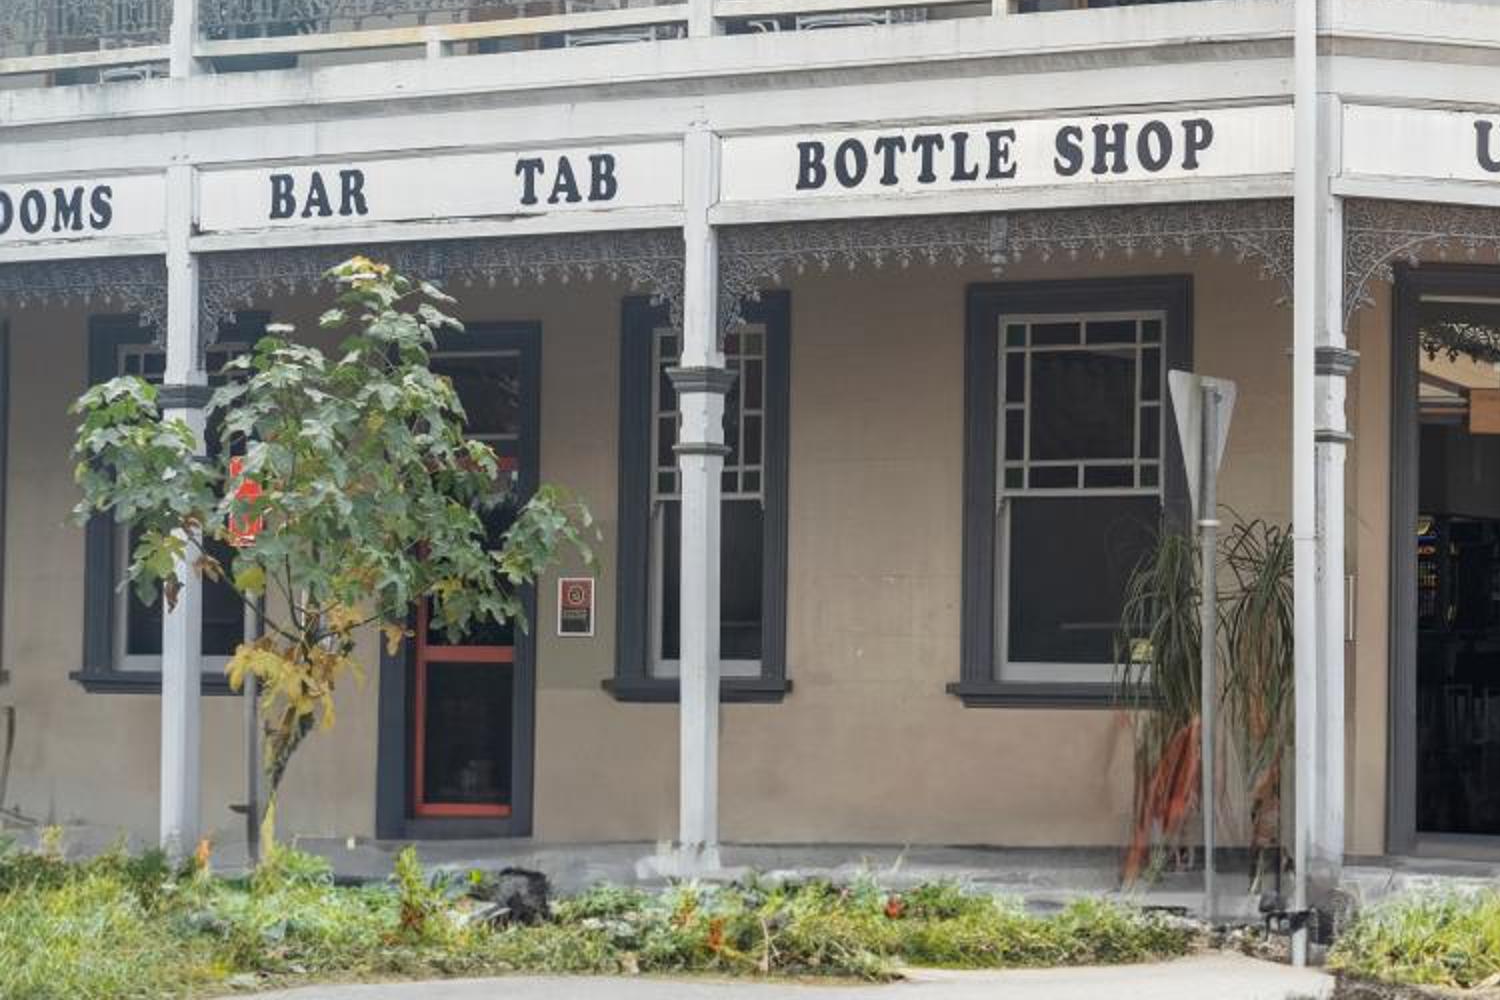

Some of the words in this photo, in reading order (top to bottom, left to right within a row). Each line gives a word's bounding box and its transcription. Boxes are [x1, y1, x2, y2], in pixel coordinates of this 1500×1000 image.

[268, 169, 370, 220] BAR
[514, 153, 619, 206] TAB
[795, 128, 1018, 192] BOTTLE
[1052, 118, 1215, 178] SHOP
